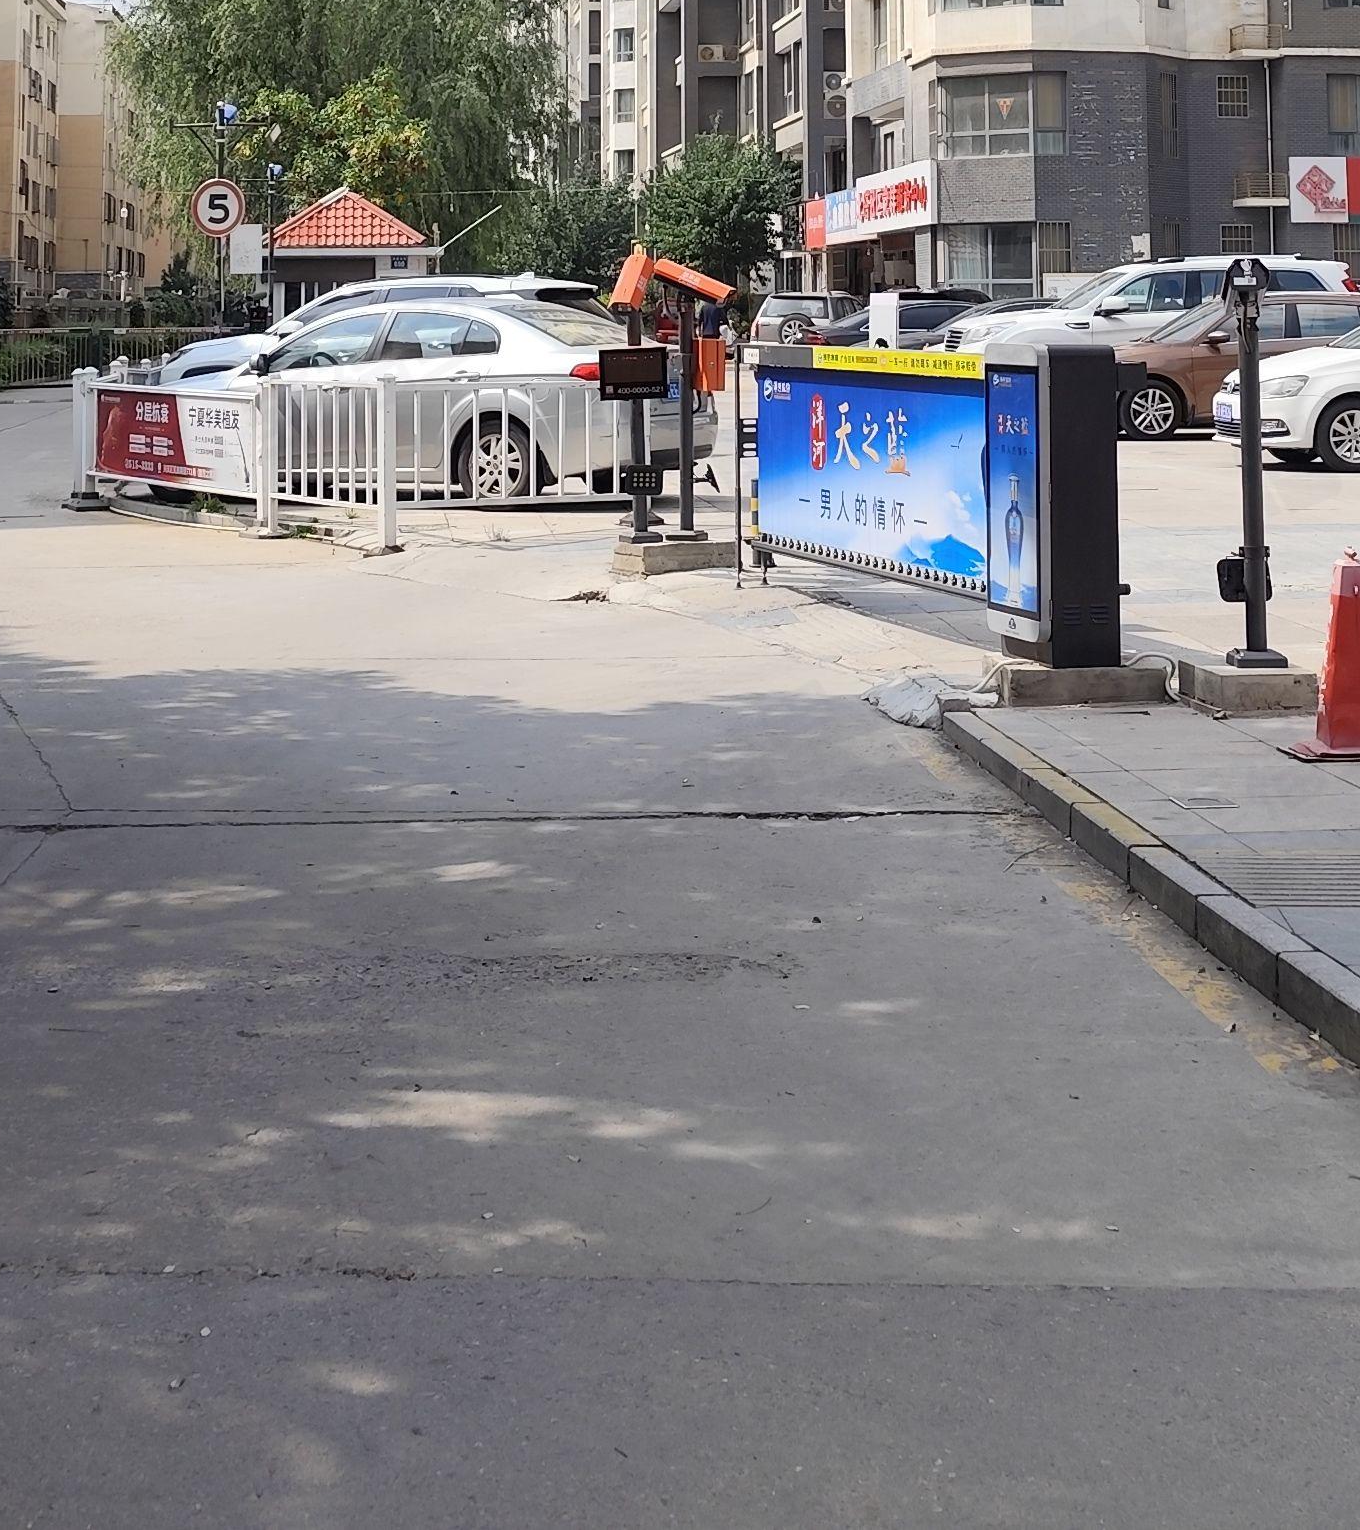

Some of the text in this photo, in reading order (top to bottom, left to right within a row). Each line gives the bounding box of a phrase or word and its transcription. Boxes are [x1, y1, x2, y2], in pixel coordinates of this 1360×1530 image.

[207, 193, 230, 224] 5
[135, 401, 169, 424] 分层抗衰
[812, 399, 826, 468] 洋河
[833, 401, 911, 477] 天之蓝
[819, 488, 906, 535] 男人的情怀
